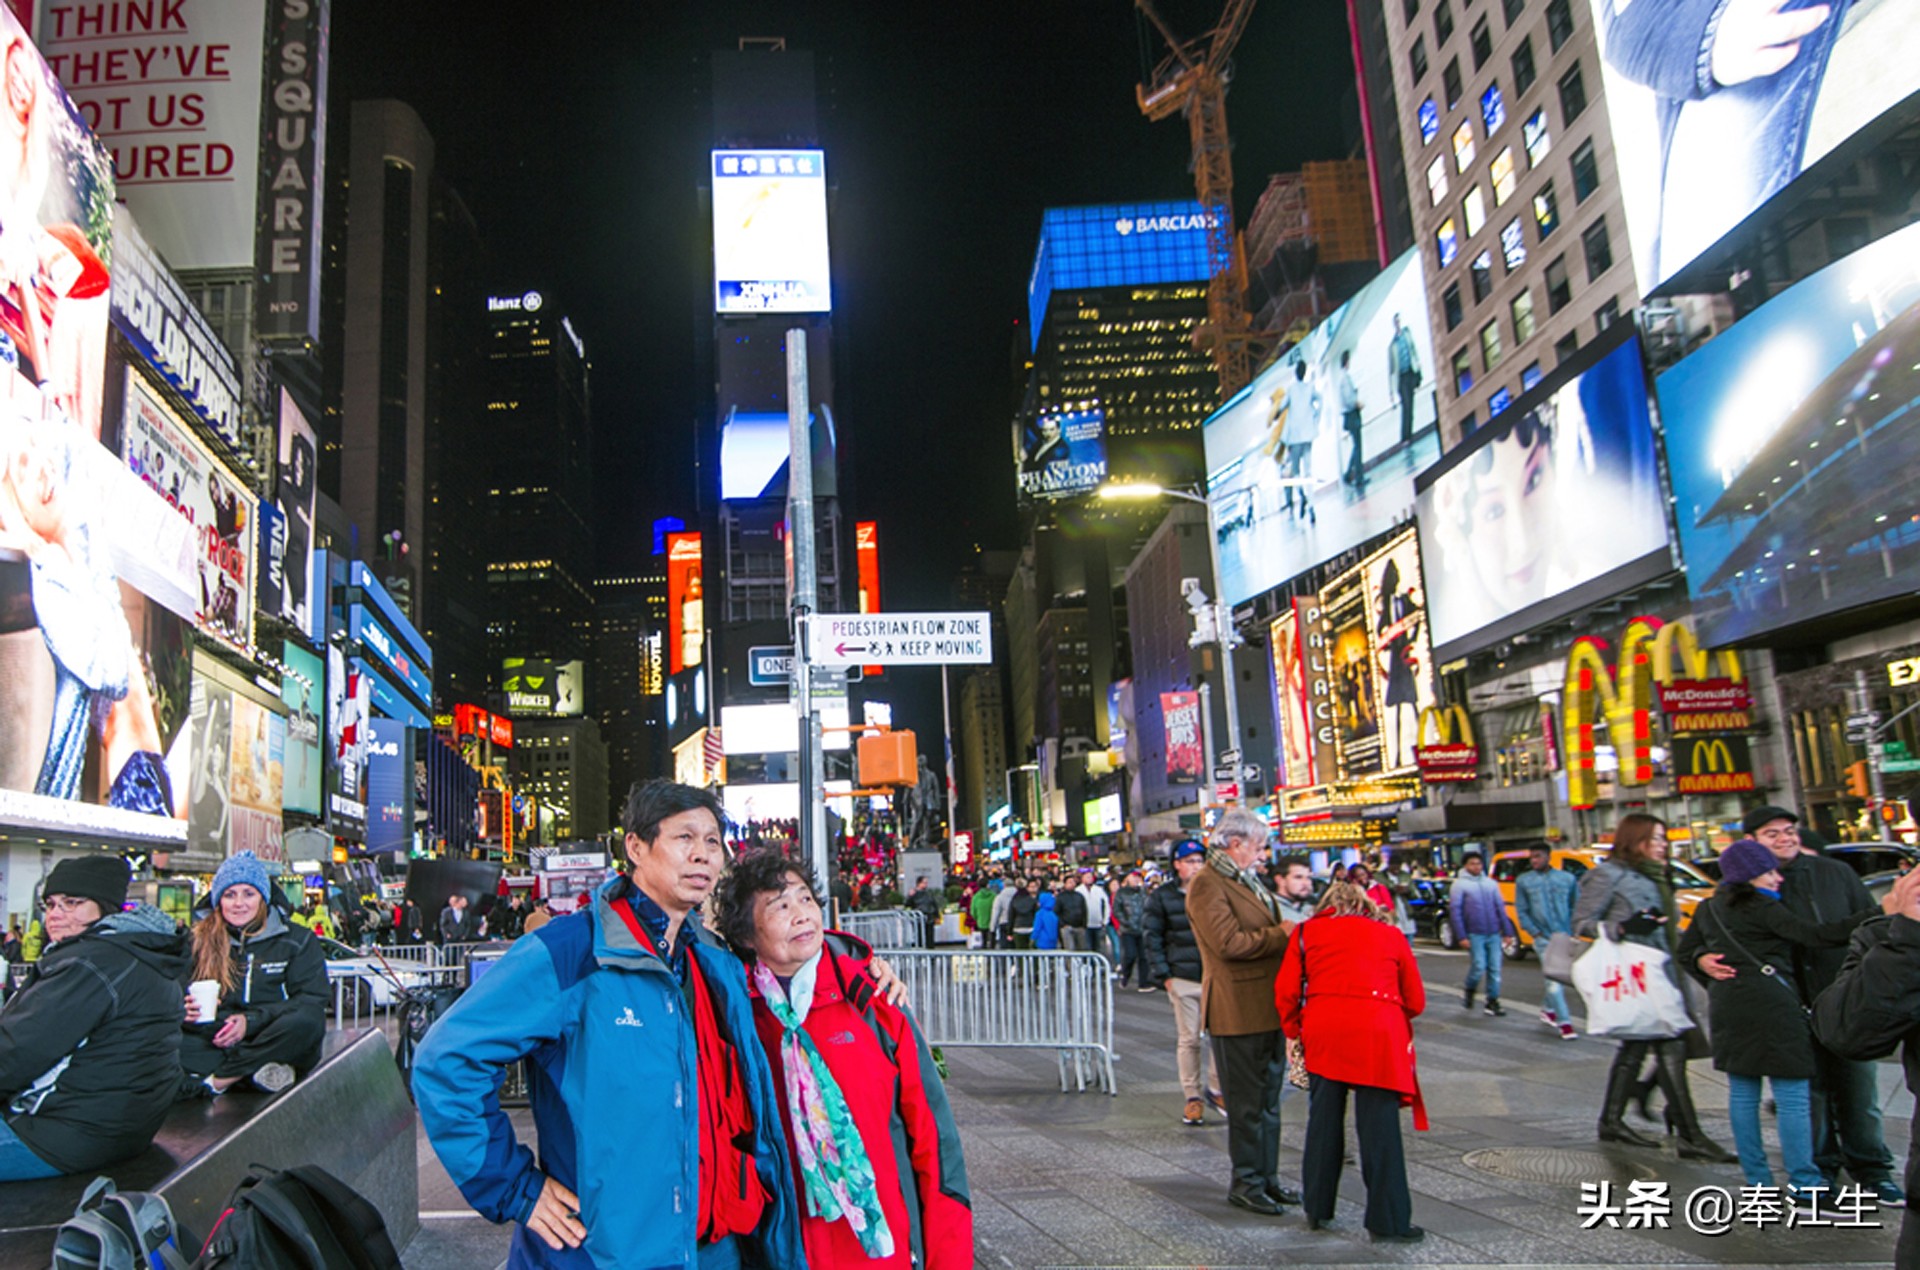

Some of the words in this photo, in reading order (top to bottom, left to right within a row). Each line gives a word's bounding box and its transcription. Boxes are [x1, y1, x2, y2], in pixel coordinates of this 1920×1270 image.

[51, 0, 188, 37] THINK
[47, 45, 231, 84] THEY'VE
[148, 94, 206, 127] US
[271, 42, 312, 273] SQUARE
[270, 302, 298, 313] NYC
[1019, 461, 1106, 488] PHANTOM
[269, 516, 285, 590] NEW
[832, 621, 909, 637] PEDESTRIAN
[912, 620, 946, 636] FLOW
[949, 620, 982, 635] ZONE
[648, 630, 663, 695] NOVOTEL
[900, 642, 932, 656] KEEP
[936, 640, 983, 656] MOVING
[763, 659, 793, 673] ONE
[1306, 606, 1334, 745] PALACE
[508, 692, 550, 706] WICKED
[1663, 687, 1747, 701] McDonald's
